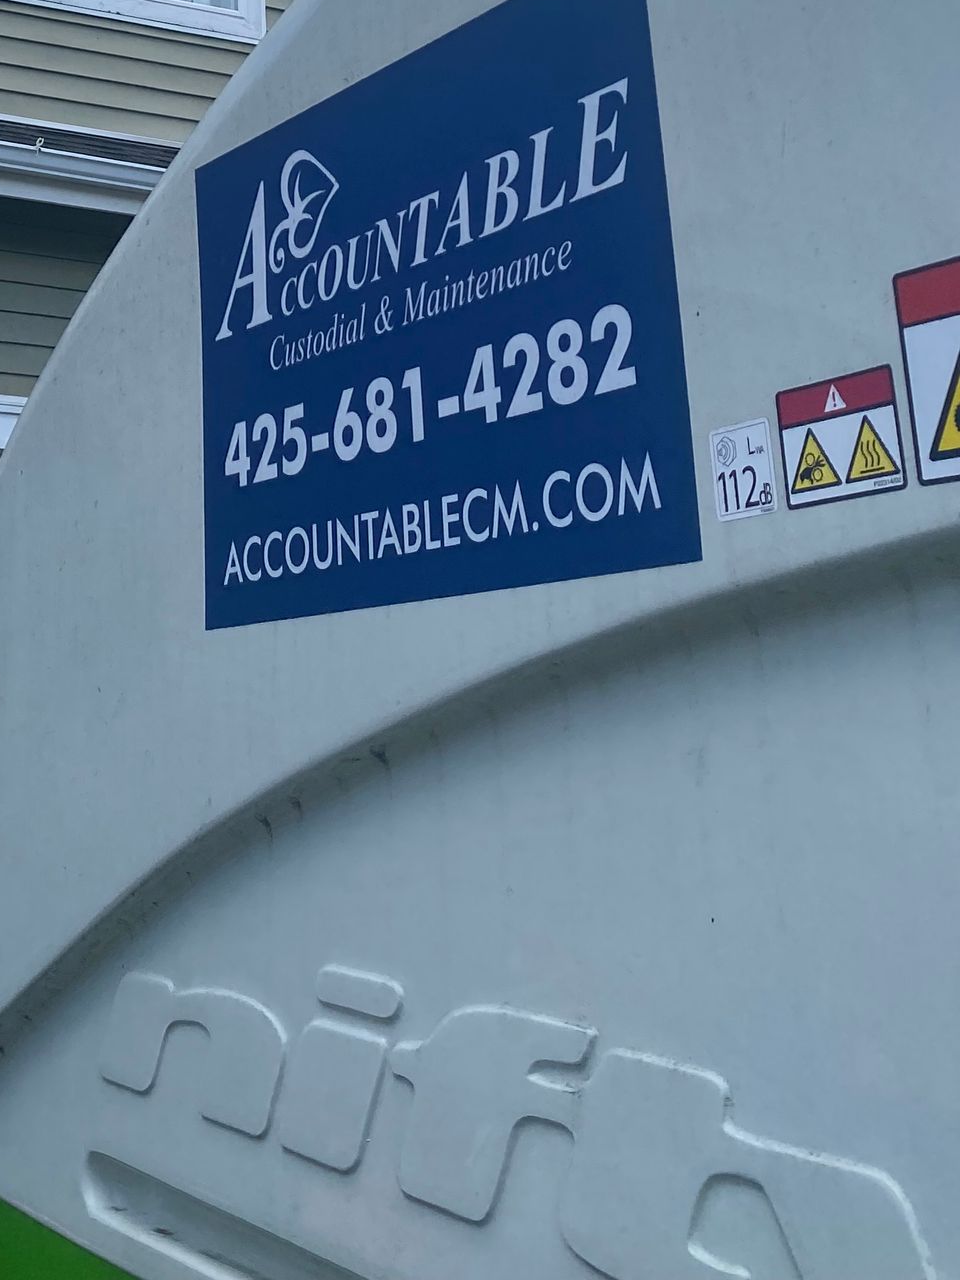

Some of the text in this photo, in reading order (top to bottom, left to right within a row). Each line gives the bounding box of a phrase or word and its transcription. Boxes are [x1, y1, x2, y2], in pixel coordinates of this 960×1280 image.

[269, 240, 574, 371] Custodial & Maintenance
[224, 304, 638, 488] 425-681-4282
[223, 452, 662, 586] ACCOUNTABLECM.COM
